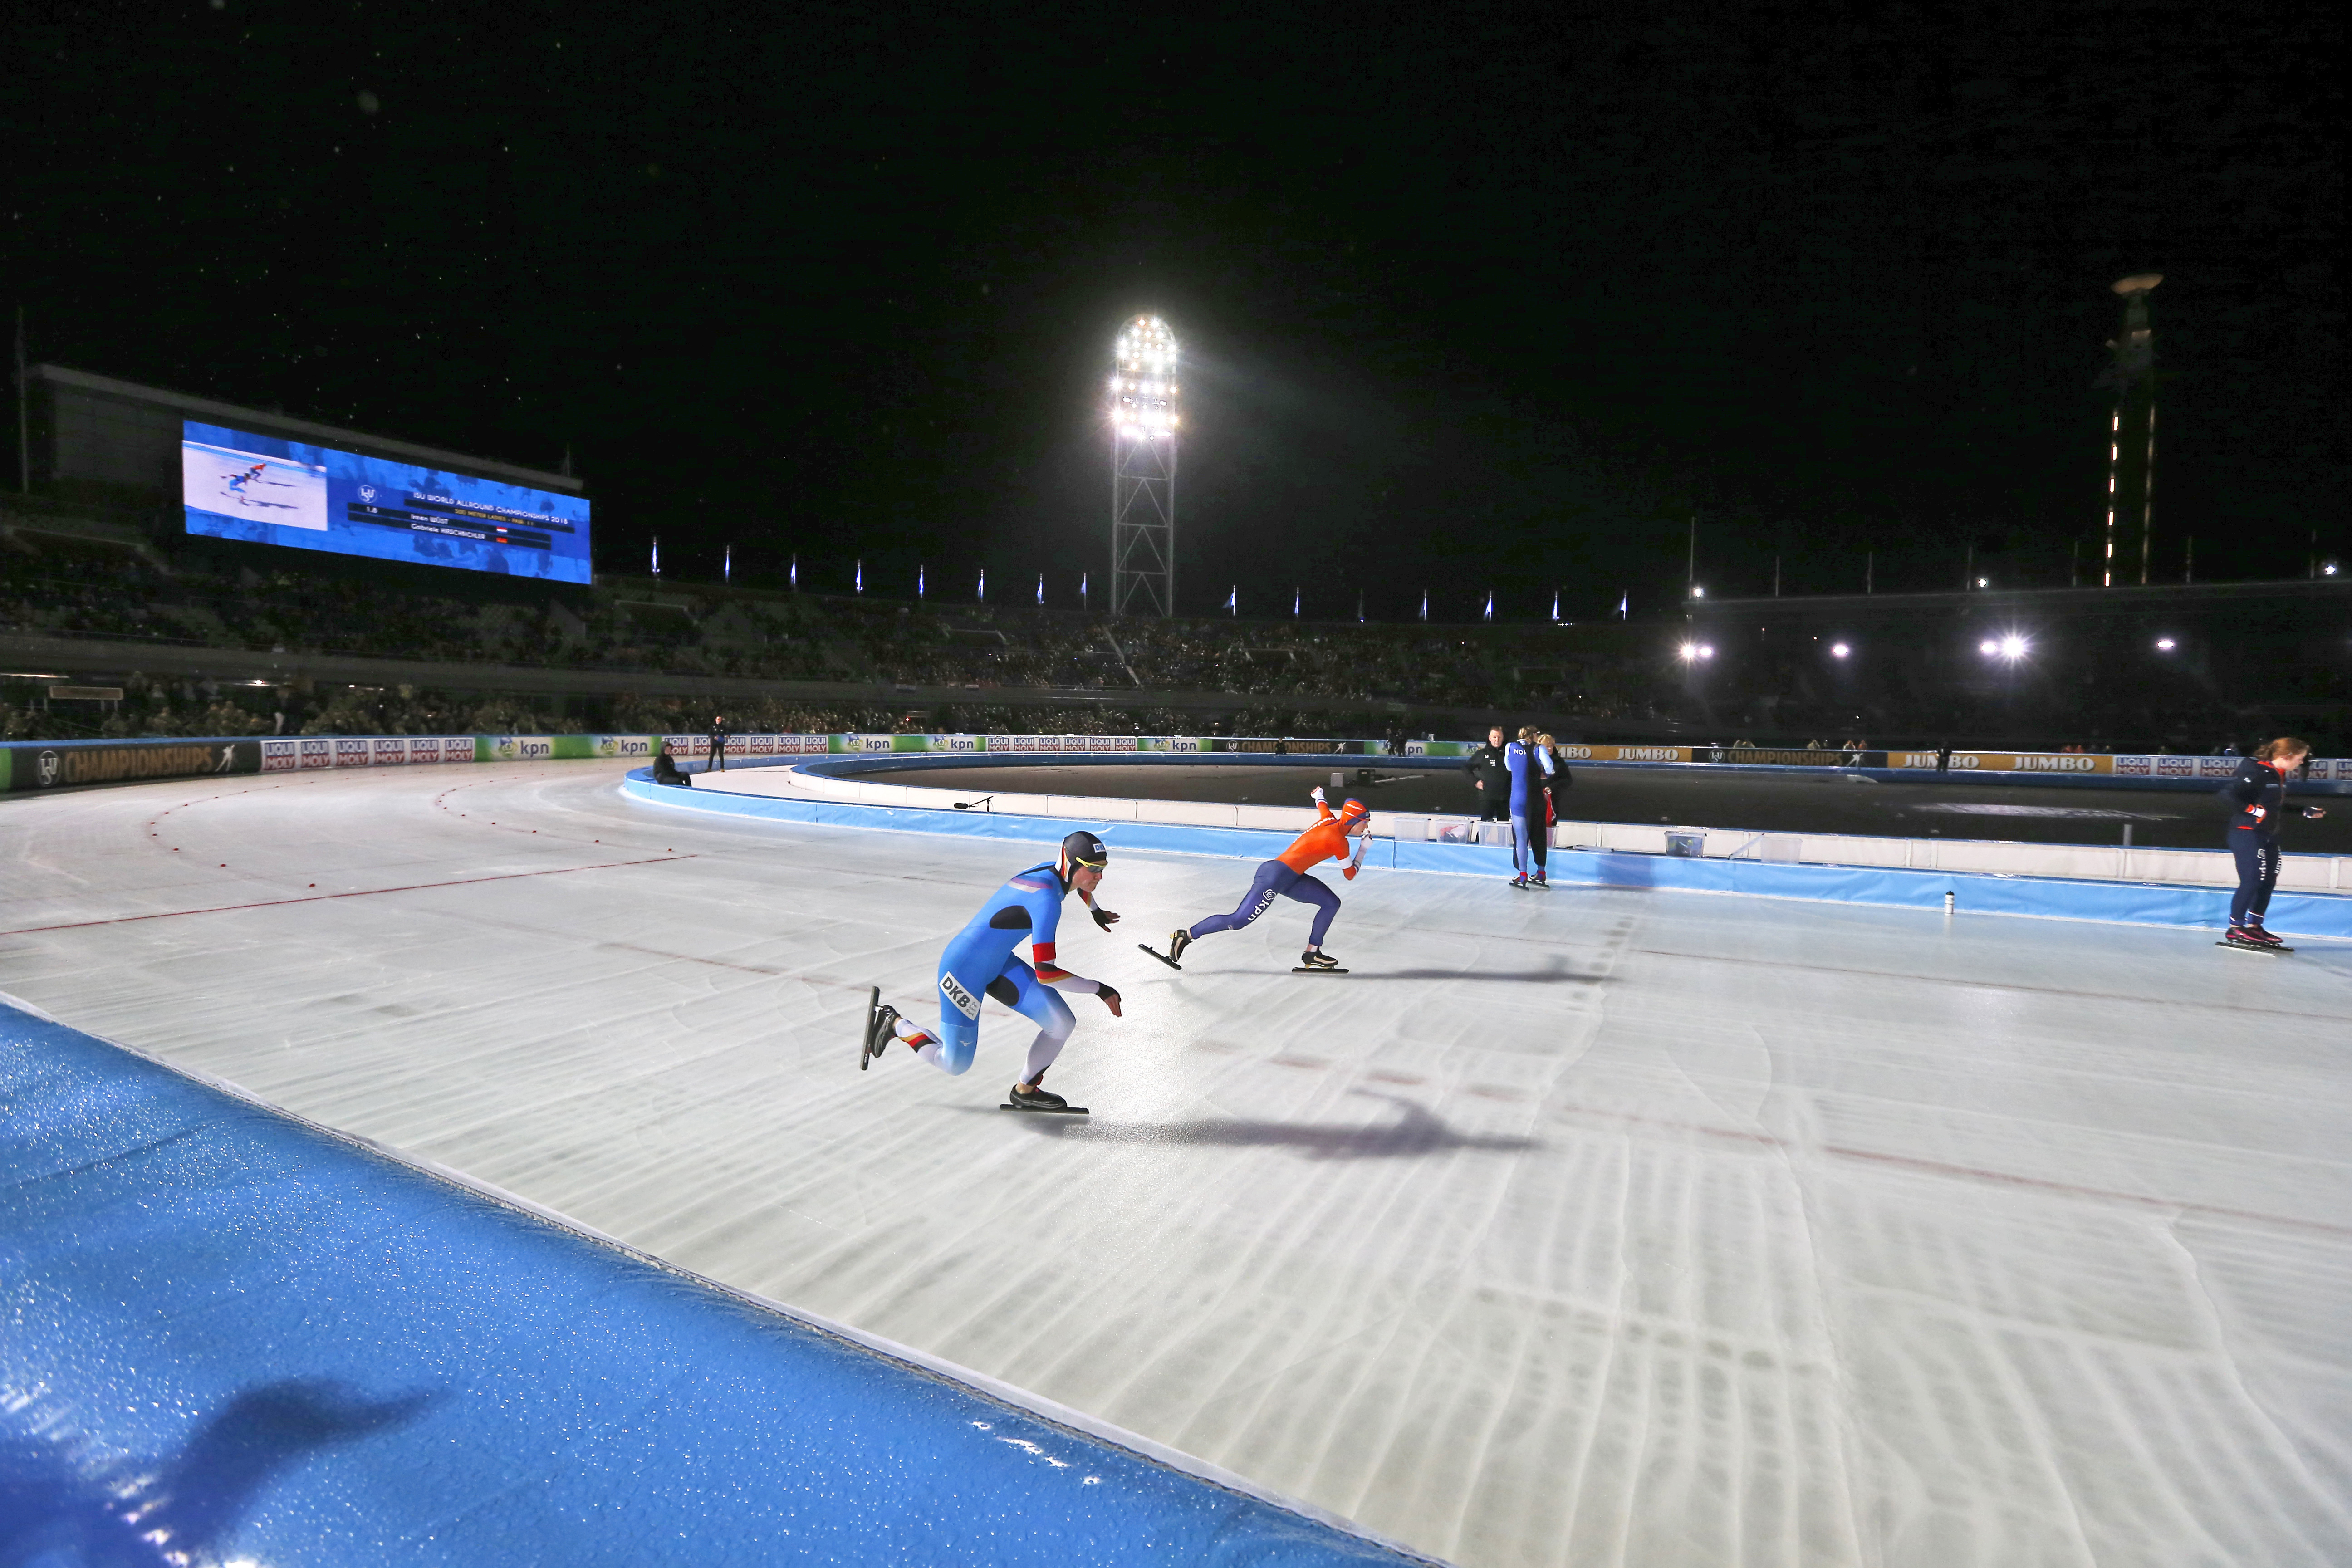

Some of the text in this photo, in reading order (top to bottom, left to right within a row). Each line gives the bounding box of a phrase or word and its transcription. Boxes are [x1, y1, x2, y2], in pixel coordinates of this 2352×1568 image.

[427, 495, 454, 505] WORLD
[456, 500, 494, 511] ALLROUND
[495, 507, 549, 521] CHAMPIONSHIPS
[551, 516, 568, 524] 2018
[266, 743, 294, 755] LIQUI
[301, 742, 328, 754] LIQUI
[337, 741, 366, 753] LIQUI
[375, 741, 403, 751] LIQUI
[411, 740, 438, 750] LIQUI
[446, 740, 472, 750] LIQUI
[520, 740, 549, 757] kpn
[621, 740, 647, 755] kpn
[866, 738, 890, 751] kpn
[951, 739, 974, 750] kpn
[1172, 740, 1196, 752] kpn
[1242, 741, 1331, 753] CHAMPONSHIPS
[1408, 746, 1423, 755] pn
[337, 754, 368, 765] MOLY
[375, 753, 404, 763] MOLY
[411, 751, 439, 762] MOLY
[446, 751, 472, 760] MOLY
[1617, 748, 1678, 760] JUMBO
[1711, 750, 1843, 766] ISU CHAMPIONSHIPS
[65, 747, 213, 782] CHAMPIONSHIPS
[266, 757, 294, 769] MOLY
[302, 755, 329, 767] MOLY
[2013, 756, 2096, 771] JUMBO
[2159, 759, 2192, 767] LIQUI
[2202, 760, 2235, 768] LIQUI
[2158, 767, 2192, 775] MOLY
[1248, 900, 1270, 921] kpn
[942, 976, 970, 1008] DKB
